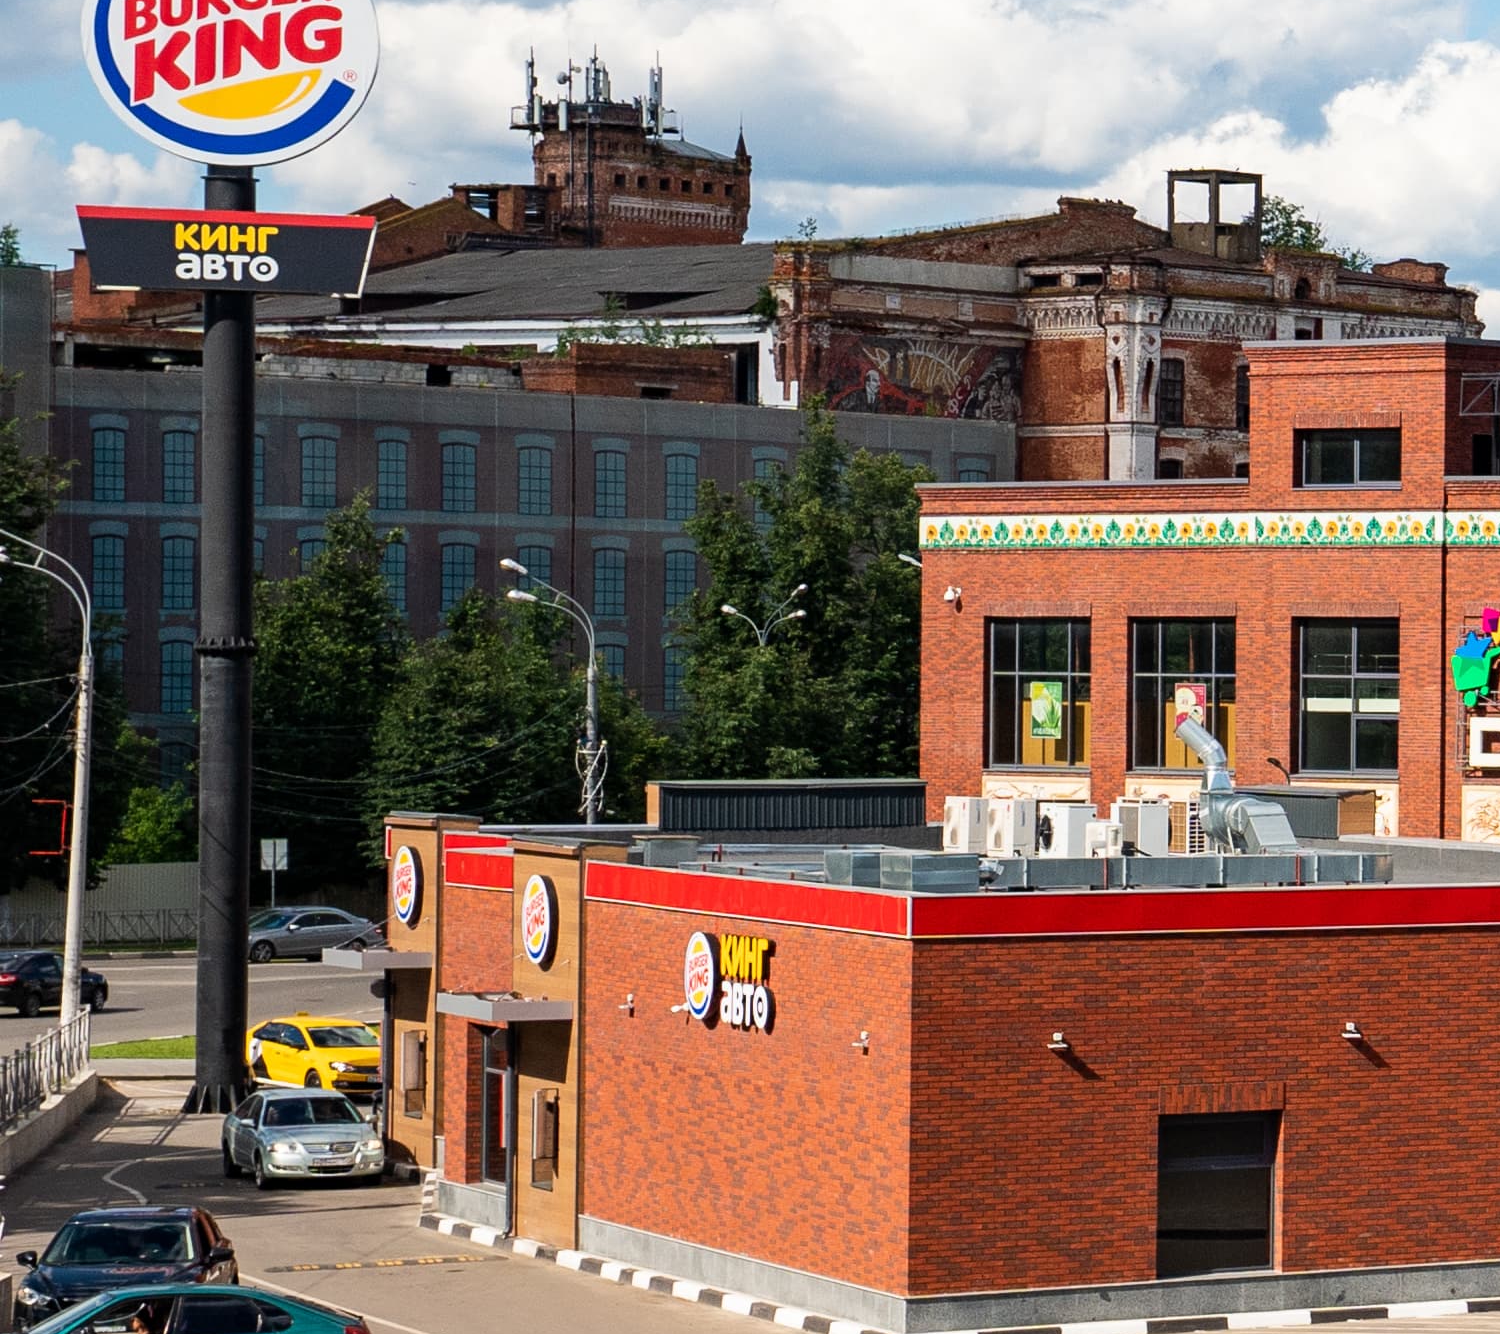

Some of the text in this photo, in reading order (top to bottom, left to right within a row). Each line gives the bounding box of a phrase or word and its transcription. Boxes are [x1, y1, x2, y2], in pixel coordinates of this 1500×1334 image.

[133, 5, 343, 103] KING
[174, 222, 279, 253] КИНГ
[720, 933, 768, 980] КИНГ
